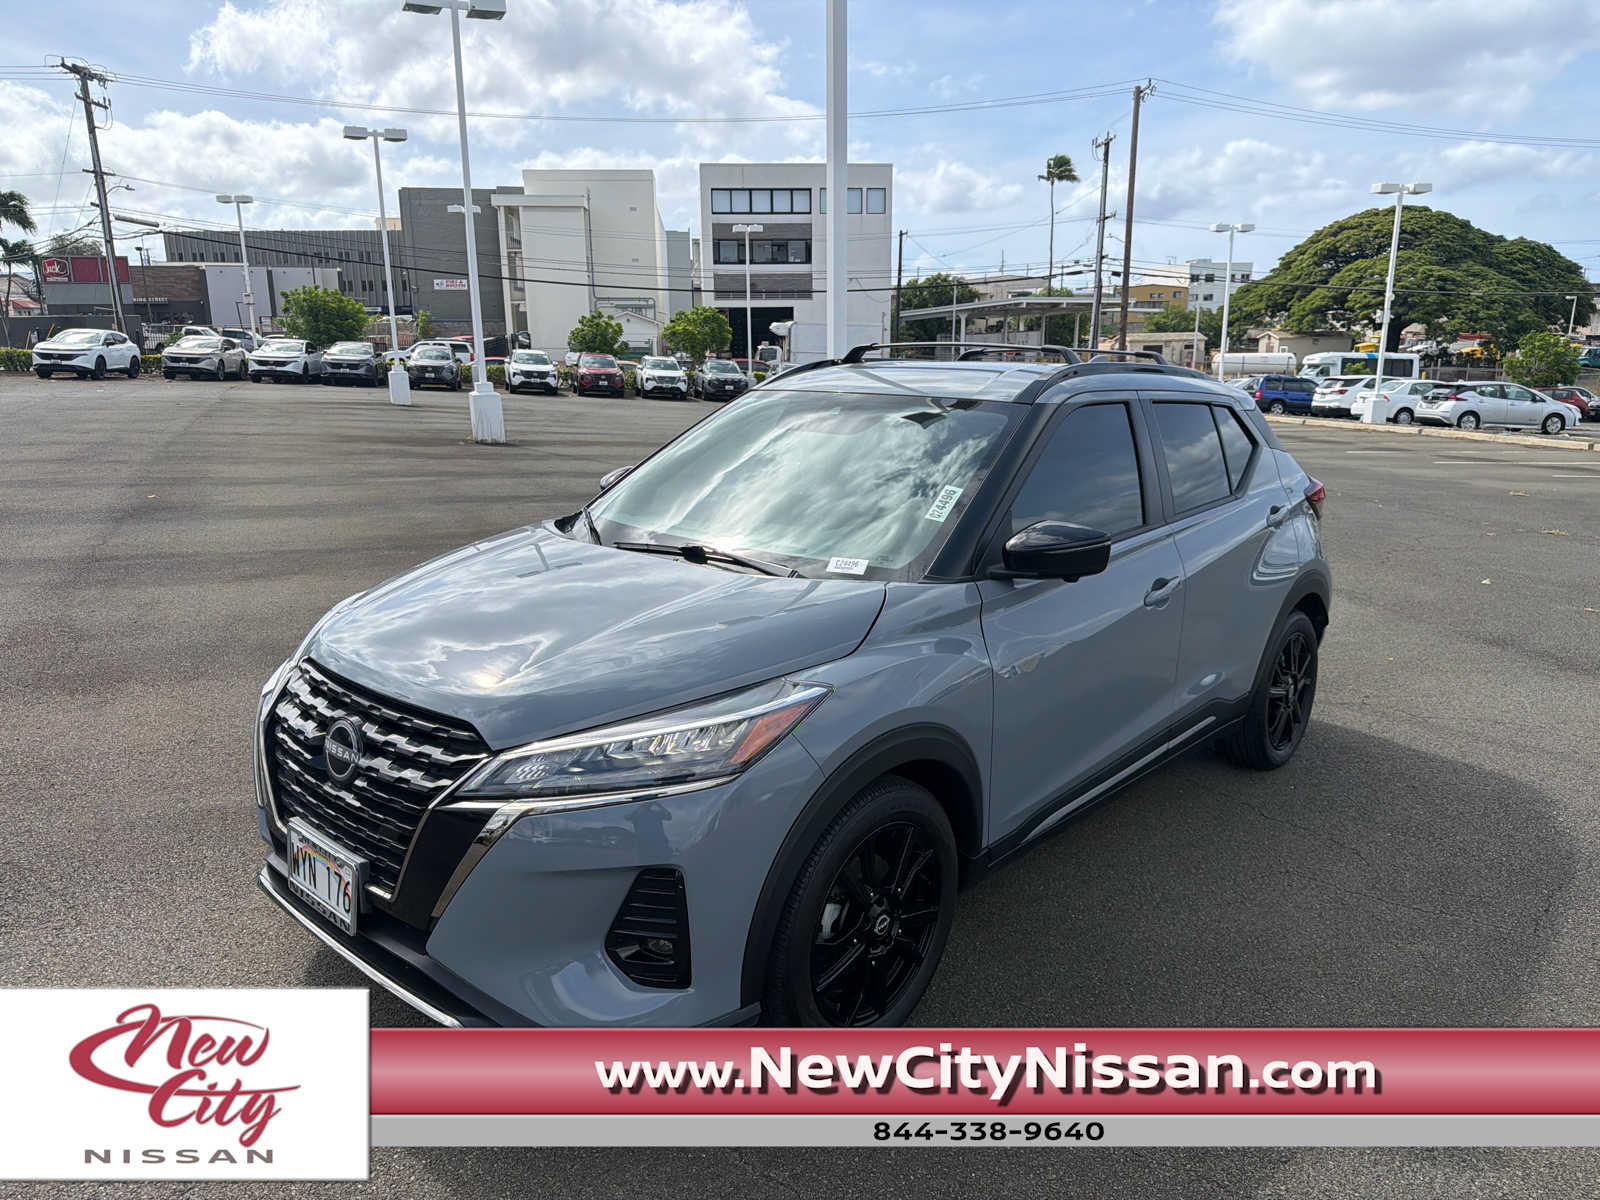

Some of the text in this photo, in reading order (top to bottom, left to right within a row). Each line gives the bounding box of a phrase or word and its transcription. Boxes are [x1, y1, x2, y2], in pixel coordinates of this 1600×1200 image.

[325, 739, 359, 763] NISSAN
[292, 842, 316, 889] WYN
[326, 866, 352, 914] 176
[289, 882, 351, 932] NISSAN
